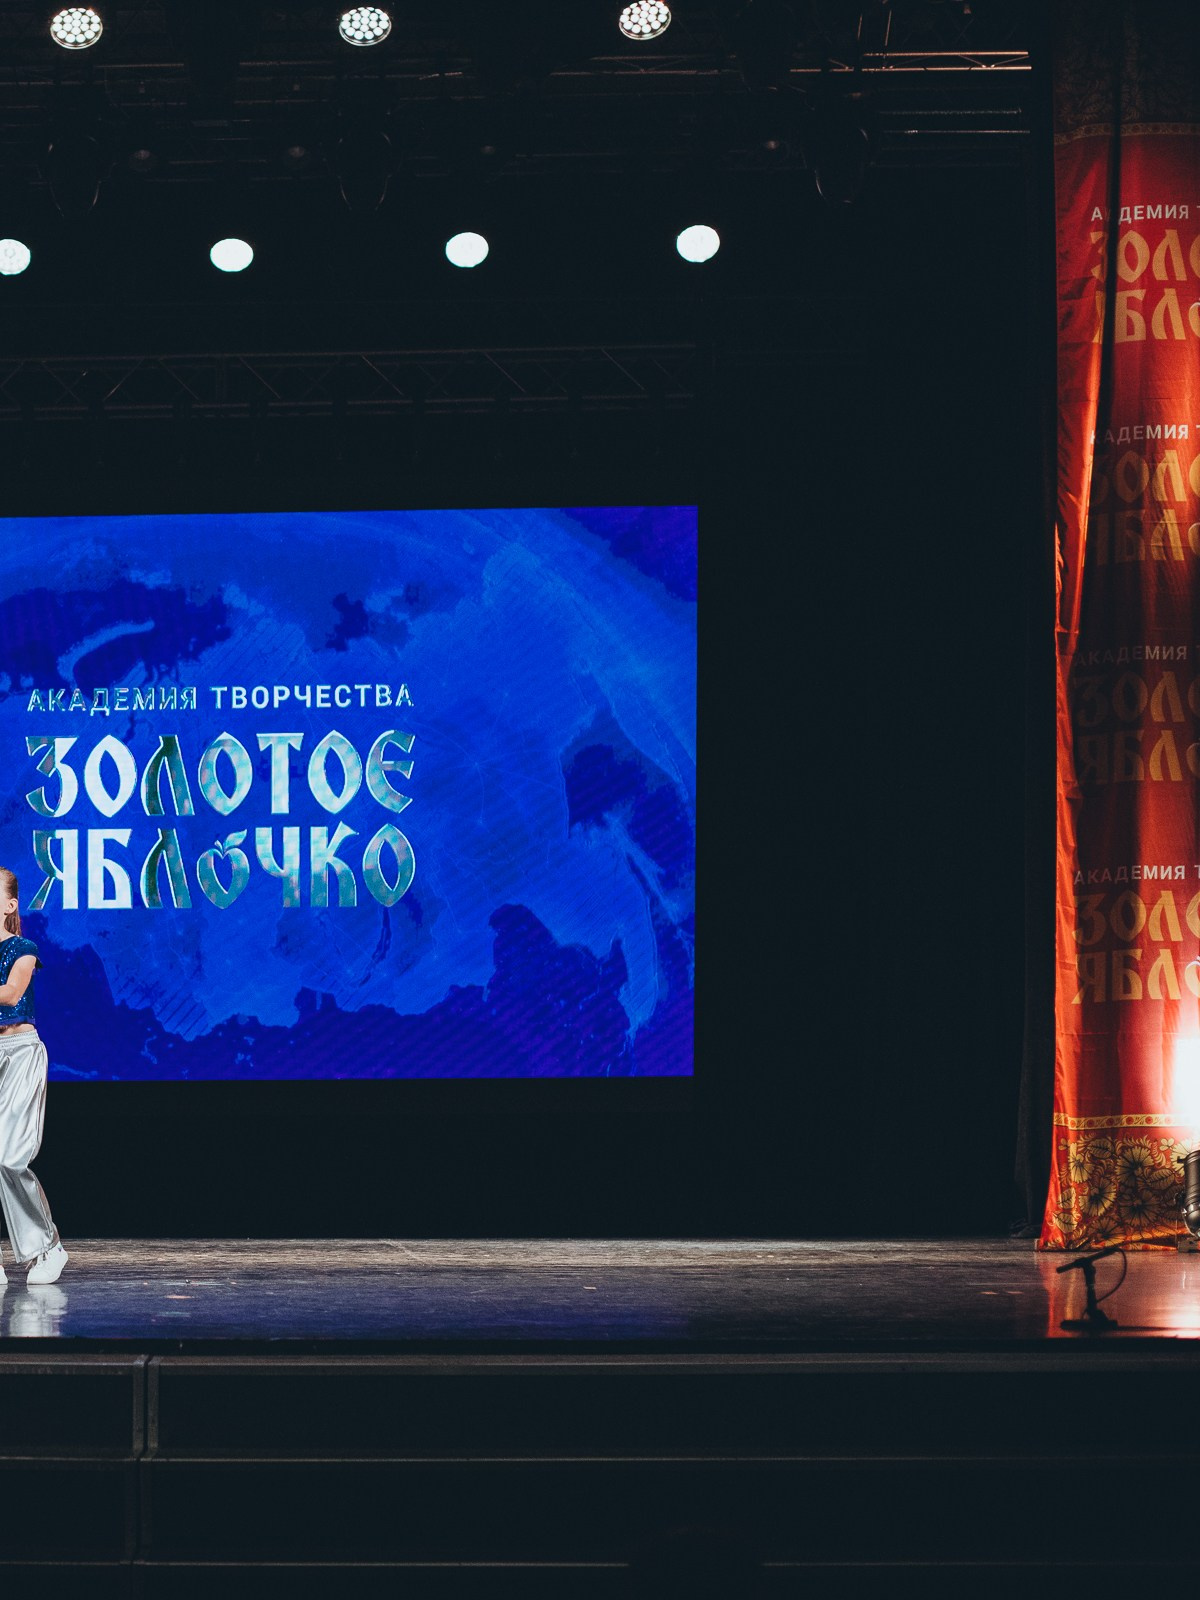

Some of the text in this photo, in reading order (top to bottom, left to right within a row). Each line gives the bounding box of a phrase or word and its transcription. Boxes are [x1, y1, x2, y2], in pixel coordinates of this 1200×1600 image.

[1090, 204, 1189, 225] АДЕМИЯ
[1075, 645, 1187, 666] АКАДЕМИЯ
[27, 683, 415, 716] АКАДЕМИЯ ТВОРЧЕСТВА
[25, 729, 416, 818] ЗОЛОТОЕ
[27, 821, 416, 910] ЯБЛОЧКО
[1074, 865, 1186, 886] АКАДЕМИЯ
